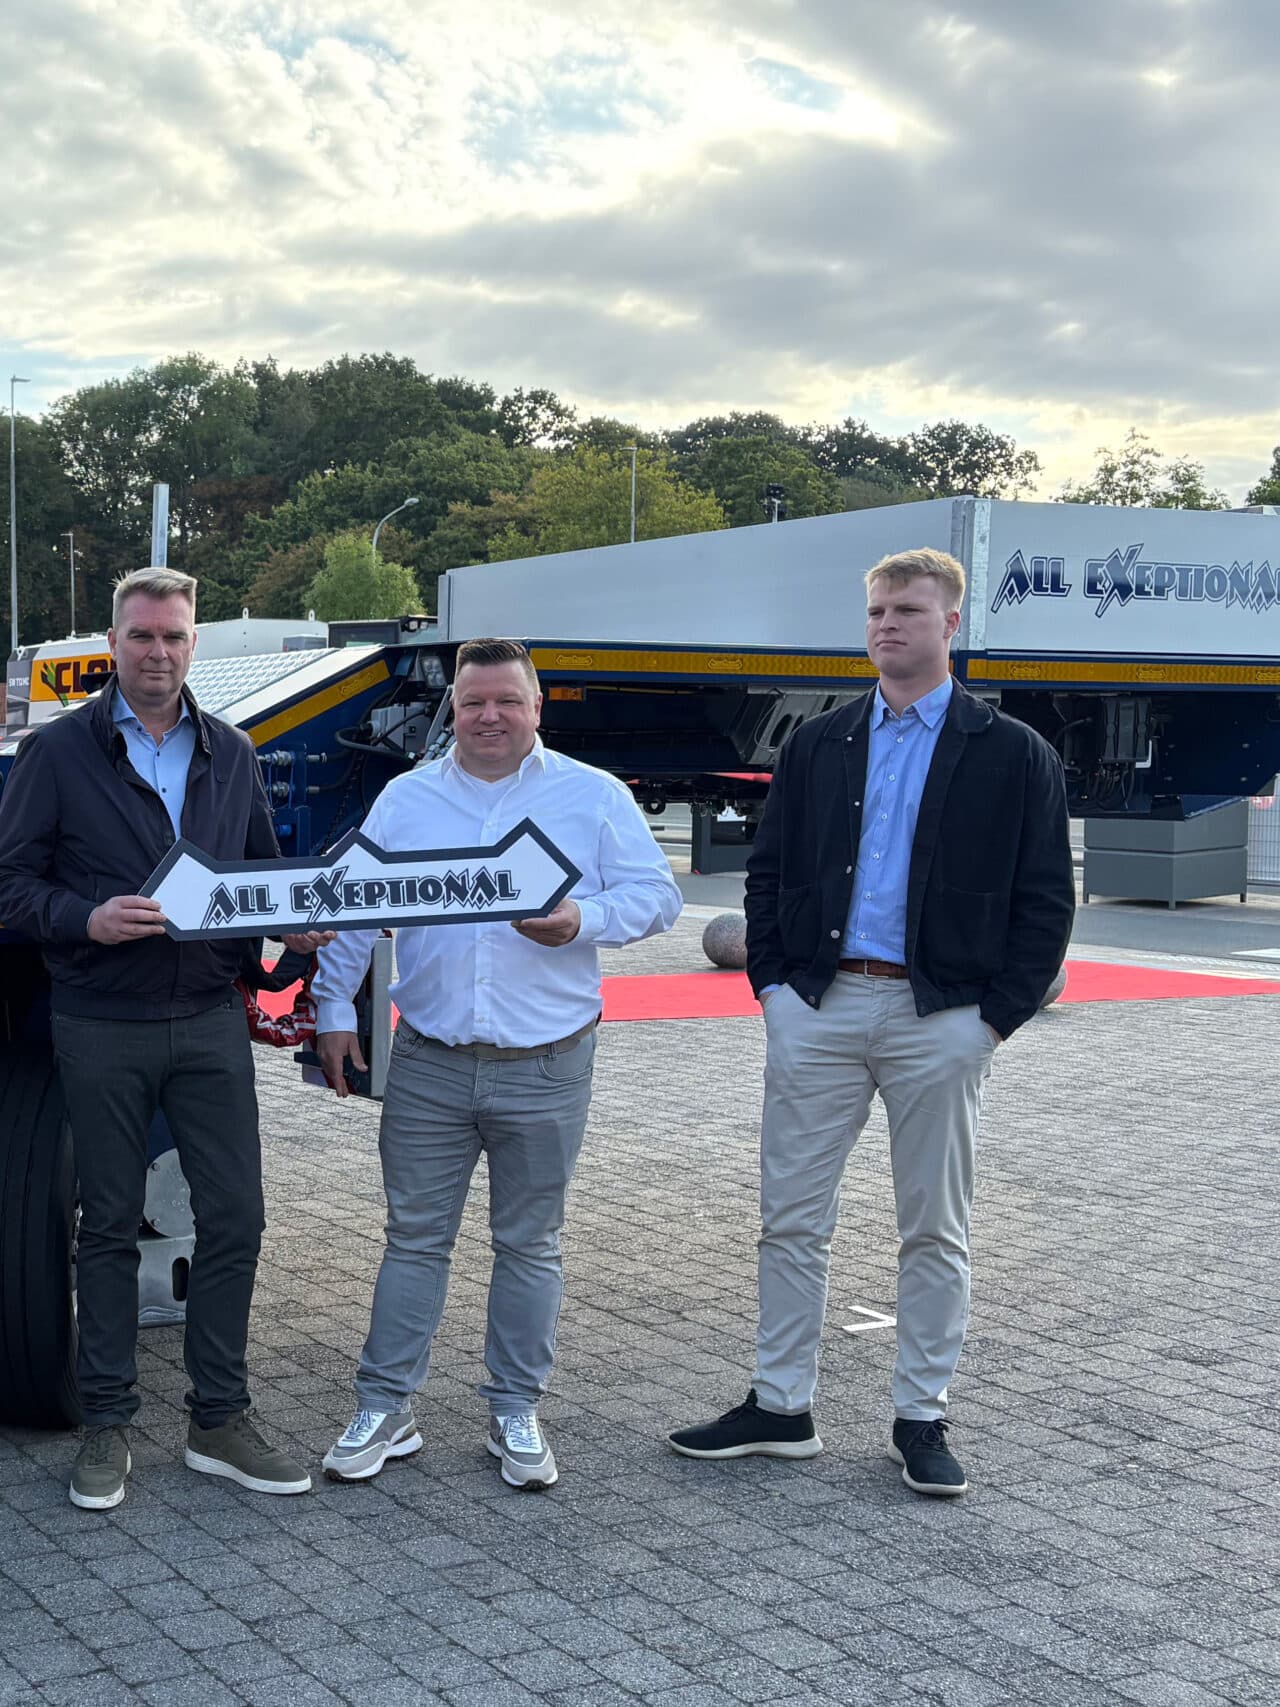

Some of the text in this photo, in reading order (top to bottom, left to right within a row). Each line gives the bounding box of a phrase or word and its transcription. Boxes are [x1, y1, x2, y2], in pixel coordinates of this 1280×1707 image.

[991, 543, 1280, 618] ALL EXEPTIONA
[201, 864, 521, 930] ALL EXEPTIONAL
